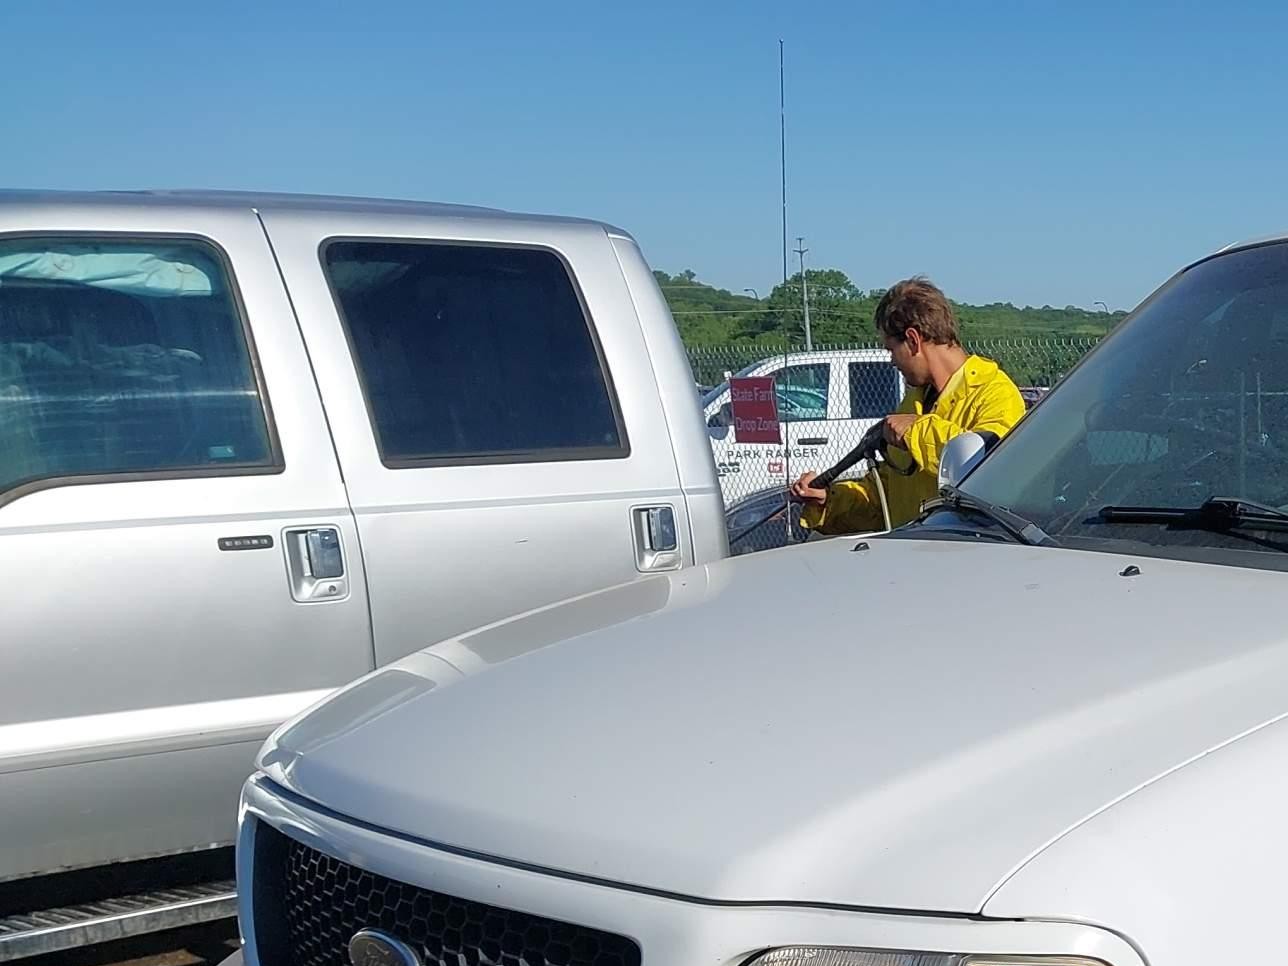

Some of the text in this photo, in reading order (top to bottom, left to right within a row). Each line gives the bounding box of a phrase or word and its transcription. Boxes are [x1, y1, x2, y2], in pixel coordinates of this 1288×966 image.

[733, 387, 753, 401] State
[736, 417, 778, 432] Drop Zone
[728, 448, 819, 460] PARK RANGER
